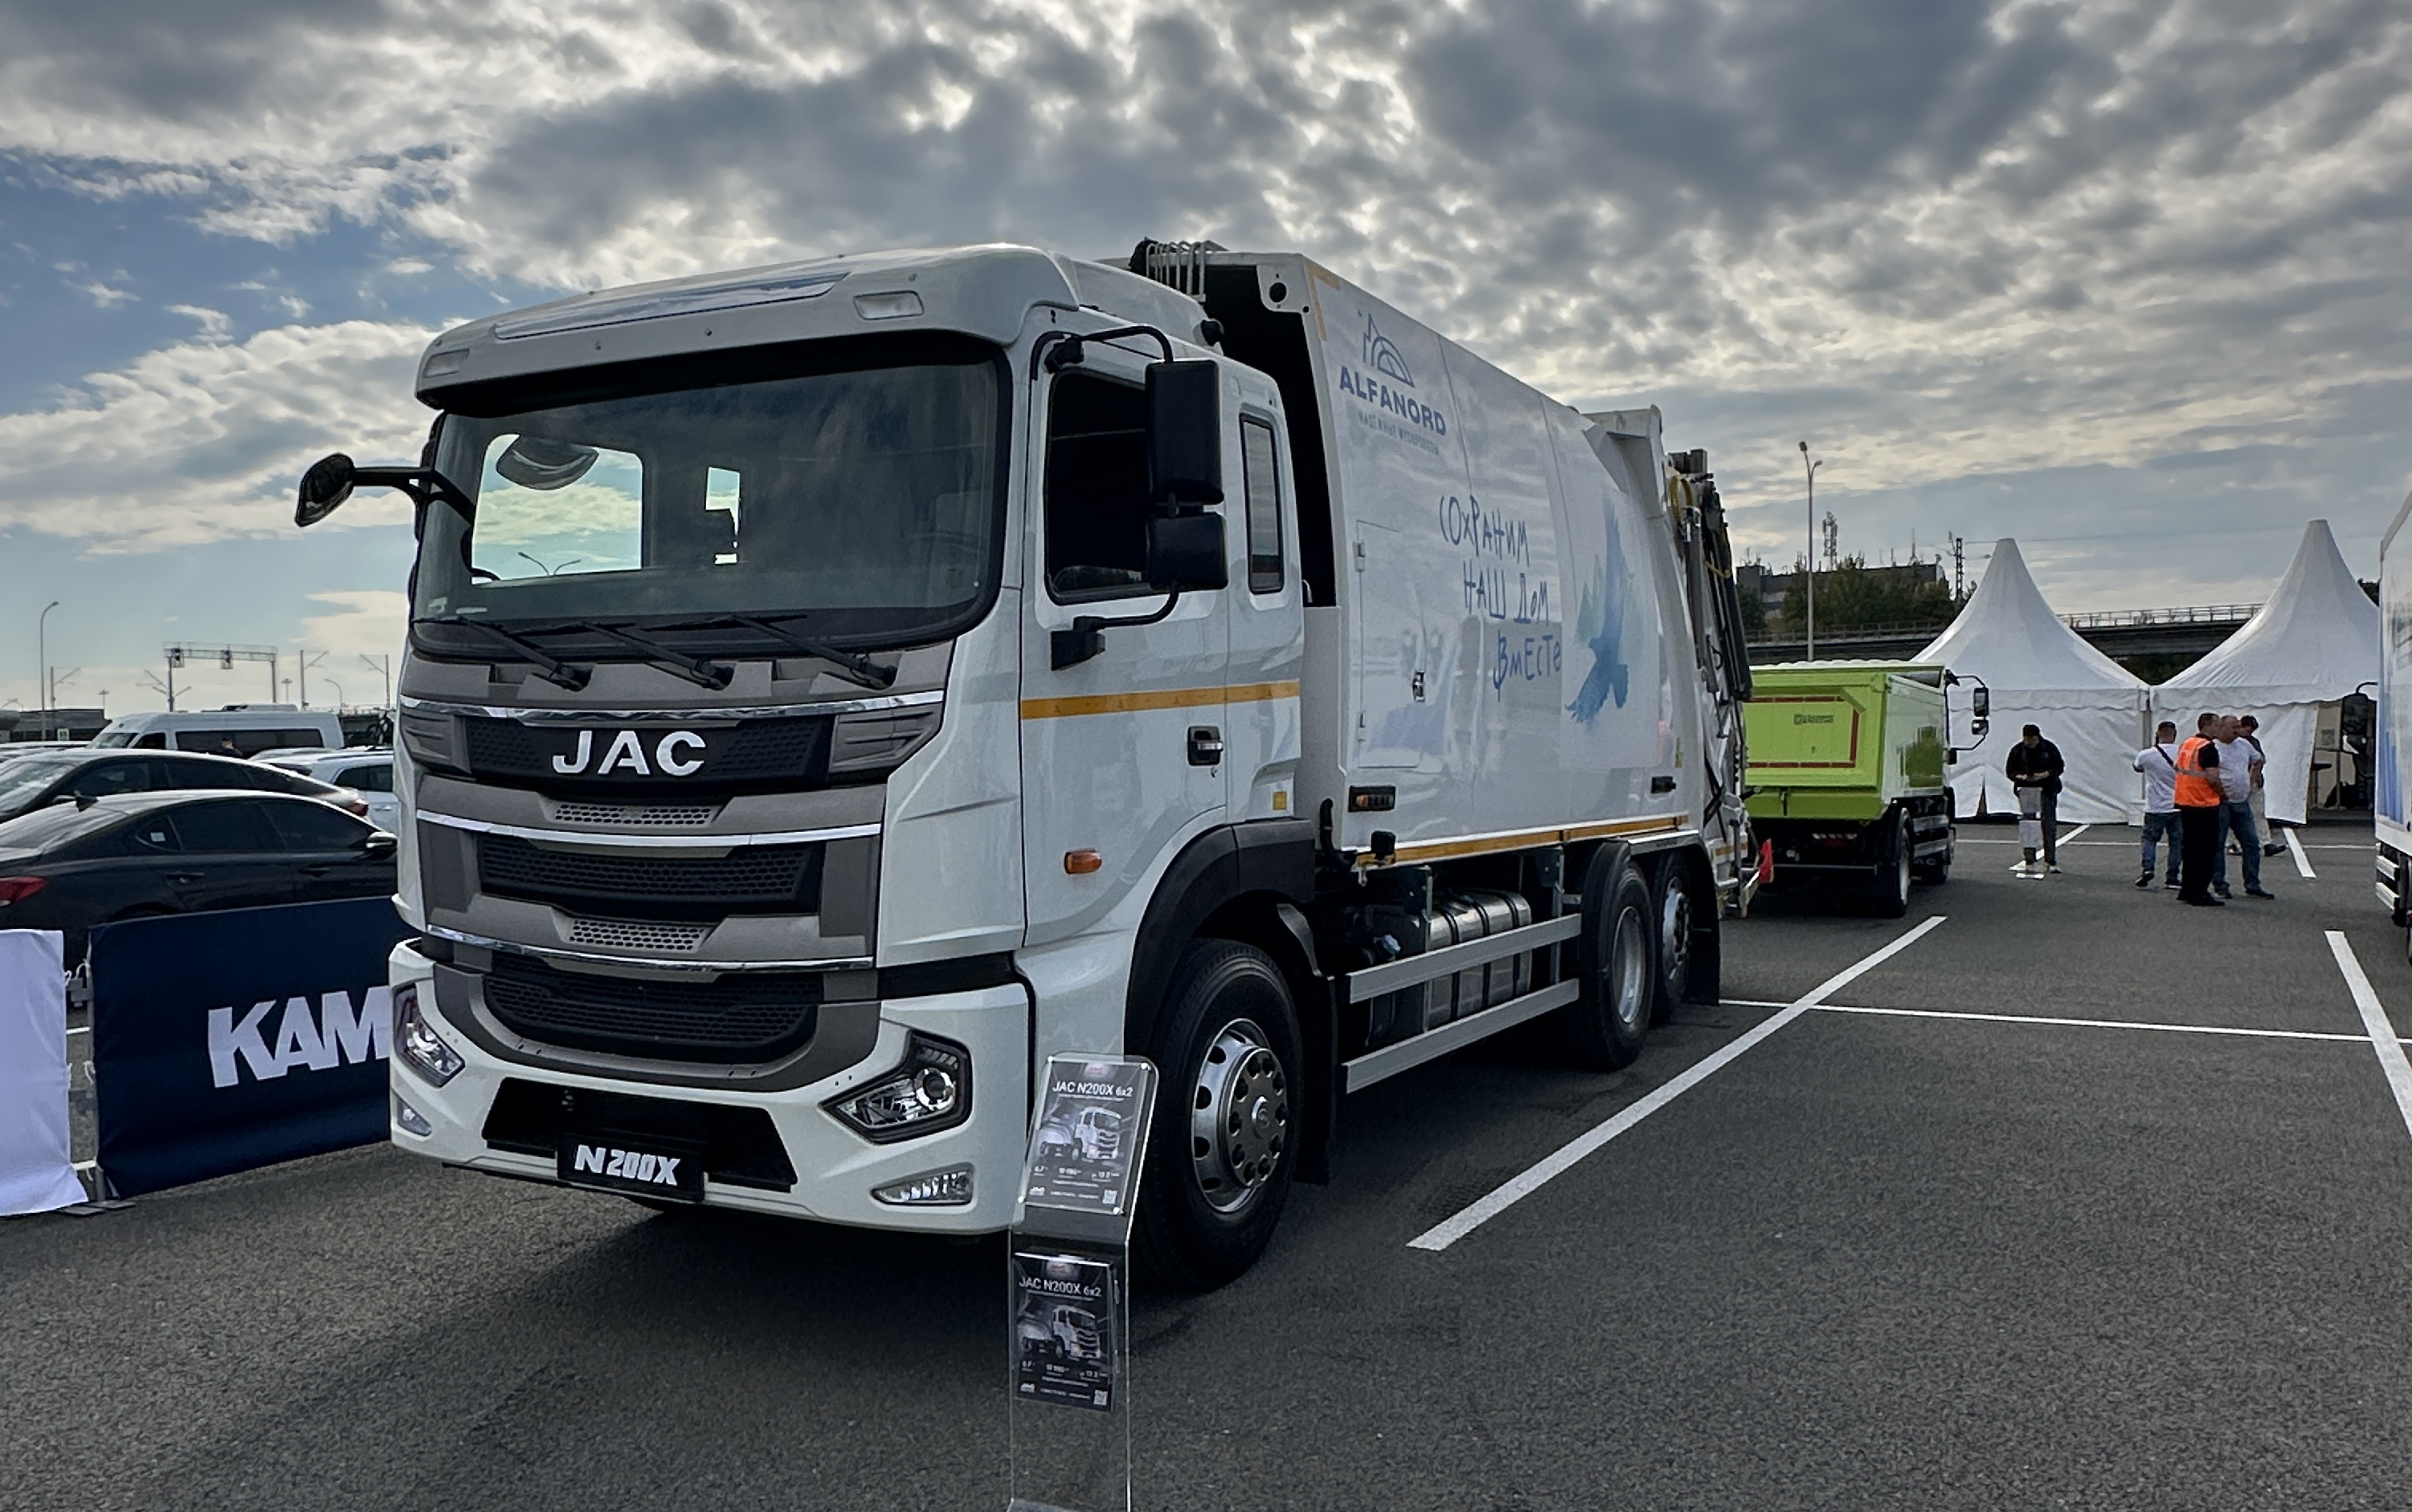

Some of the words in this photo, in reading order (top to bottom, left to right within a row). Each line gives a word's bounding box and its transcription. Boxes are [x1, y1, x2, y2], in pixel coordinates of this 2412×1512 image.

[1339, 365, 1447, 436] ALFANORD
[1463, 558, 1507, 620] НАШ
[1513, 573, 1550, 627] ДОМ
[552, 730, 707, 777] JAC
[1052, 1081, 1076, 1093] JAC
[1077, 1082, 1113, 1096] N200X
[1019, 1277, 1042, 1289] JAC
[1043, 1279, 1081, 1295] N200X
